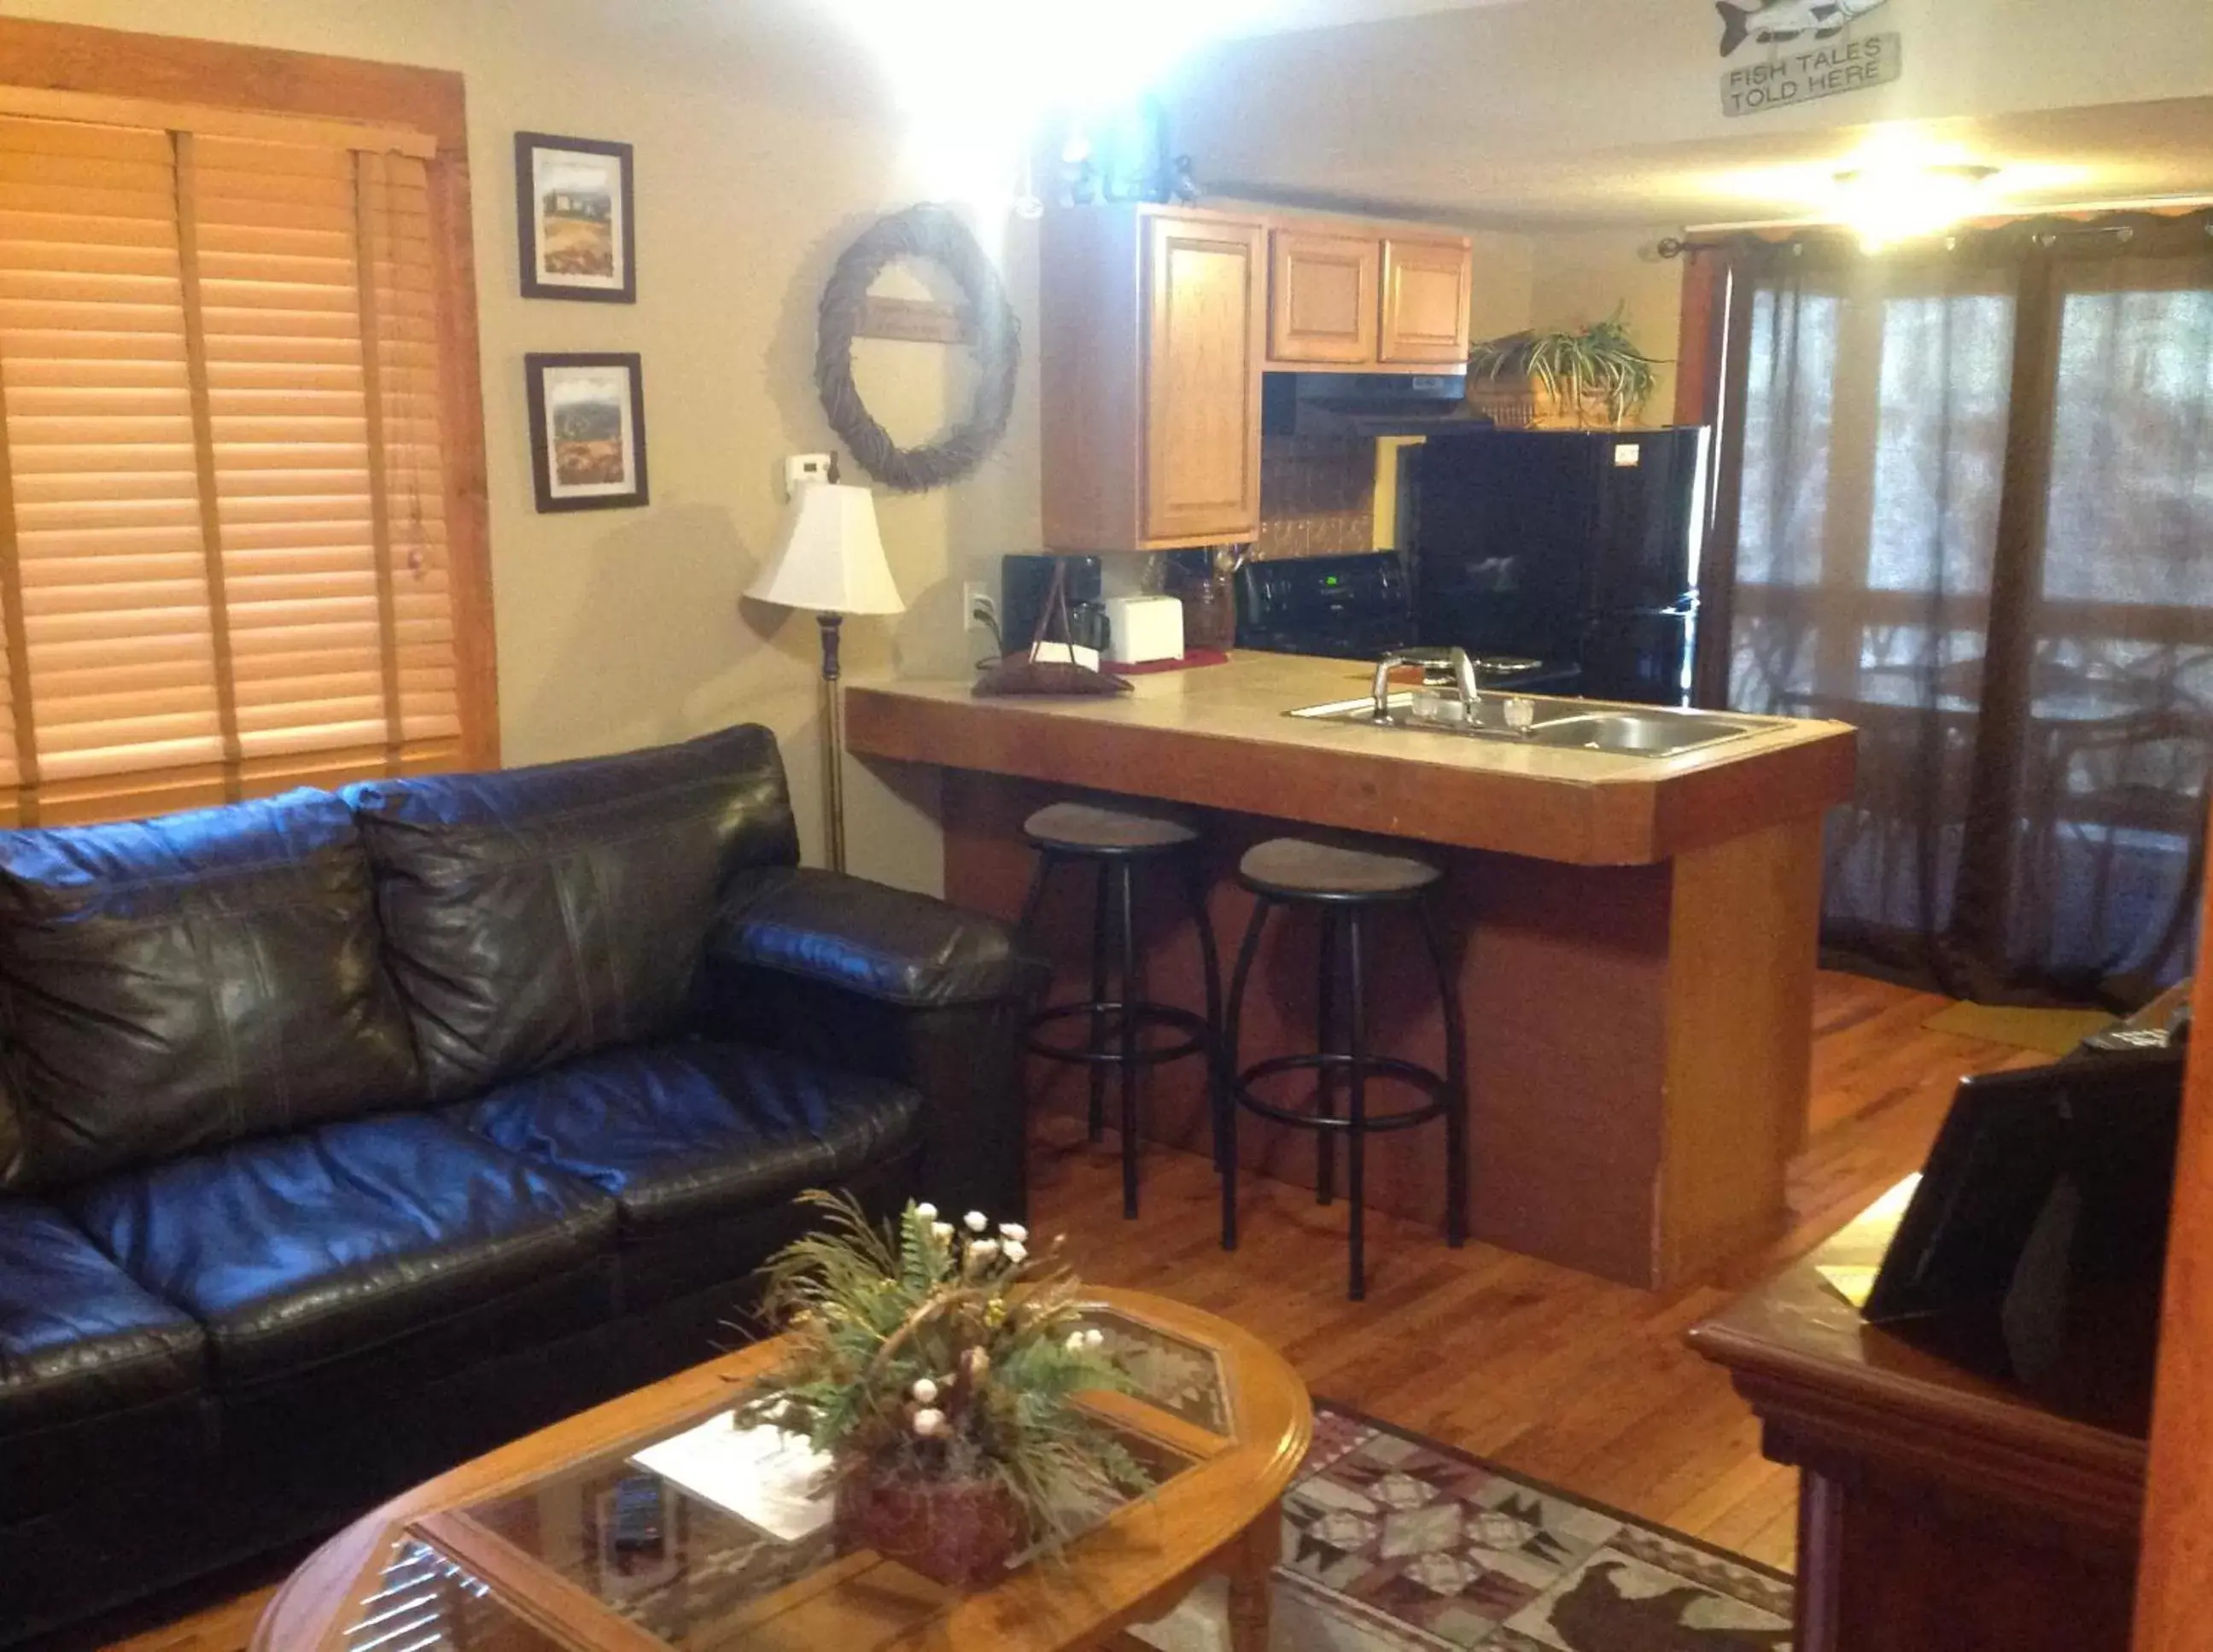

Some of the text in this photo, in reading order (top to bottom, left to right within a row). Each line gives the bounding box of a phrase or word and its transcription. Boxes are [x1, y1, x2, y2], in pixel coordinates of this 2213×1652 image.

[1730, 38, 1882, 87] FISH TALES
[1731, 61, 1878, 110] TOLD HERE
